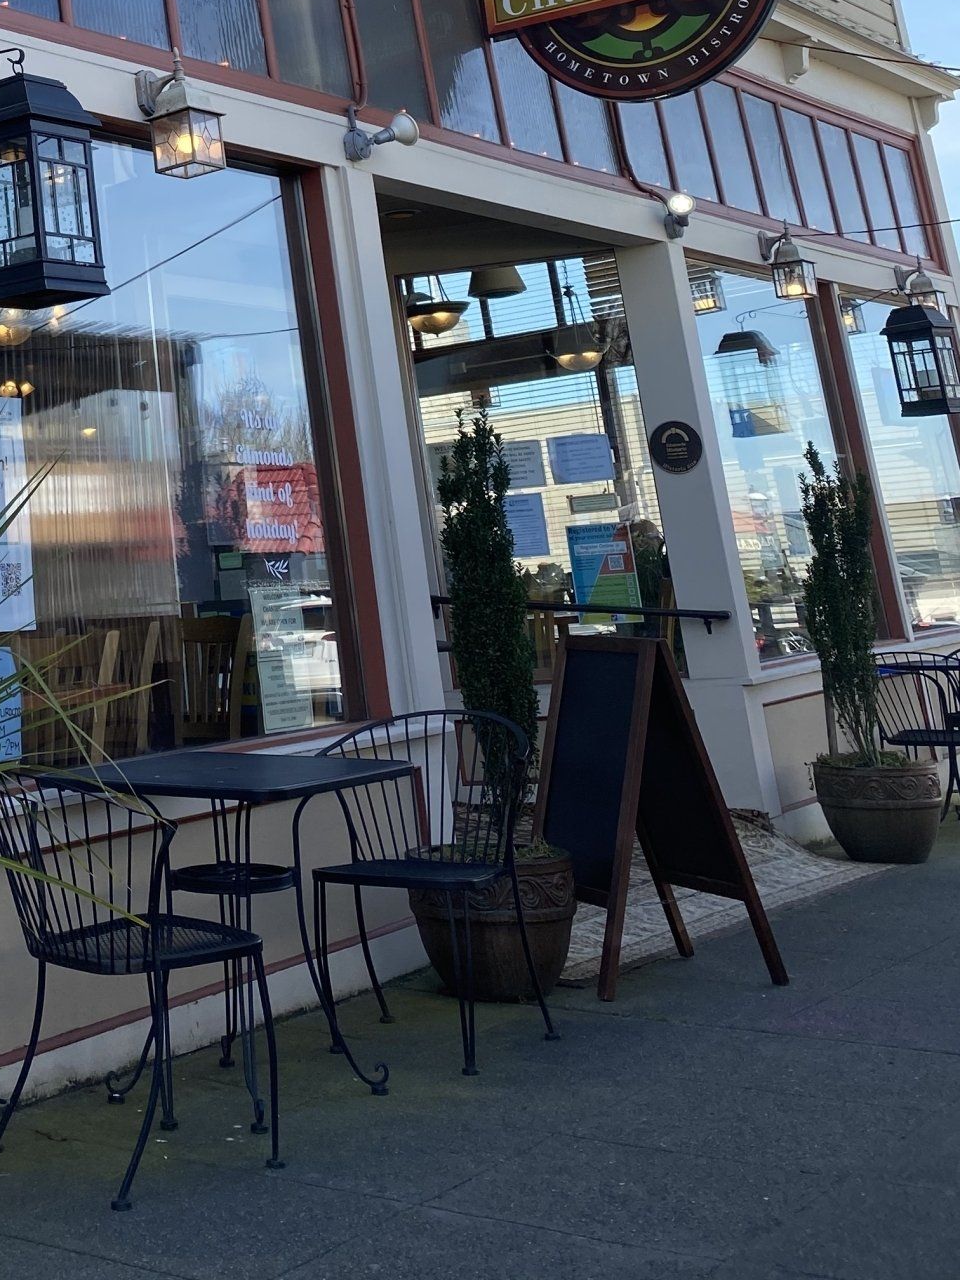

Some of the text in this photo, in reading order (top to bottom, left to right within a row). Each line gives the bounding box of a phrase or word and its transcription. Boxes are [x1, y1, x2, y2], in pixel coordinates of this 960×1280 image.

[544, 40, 670, 87] HOMETOWN
[235, 444, 294, 467] Edmonds
[277, 482, 294, 508] of
[246, 519, 299, 545] holiday!
